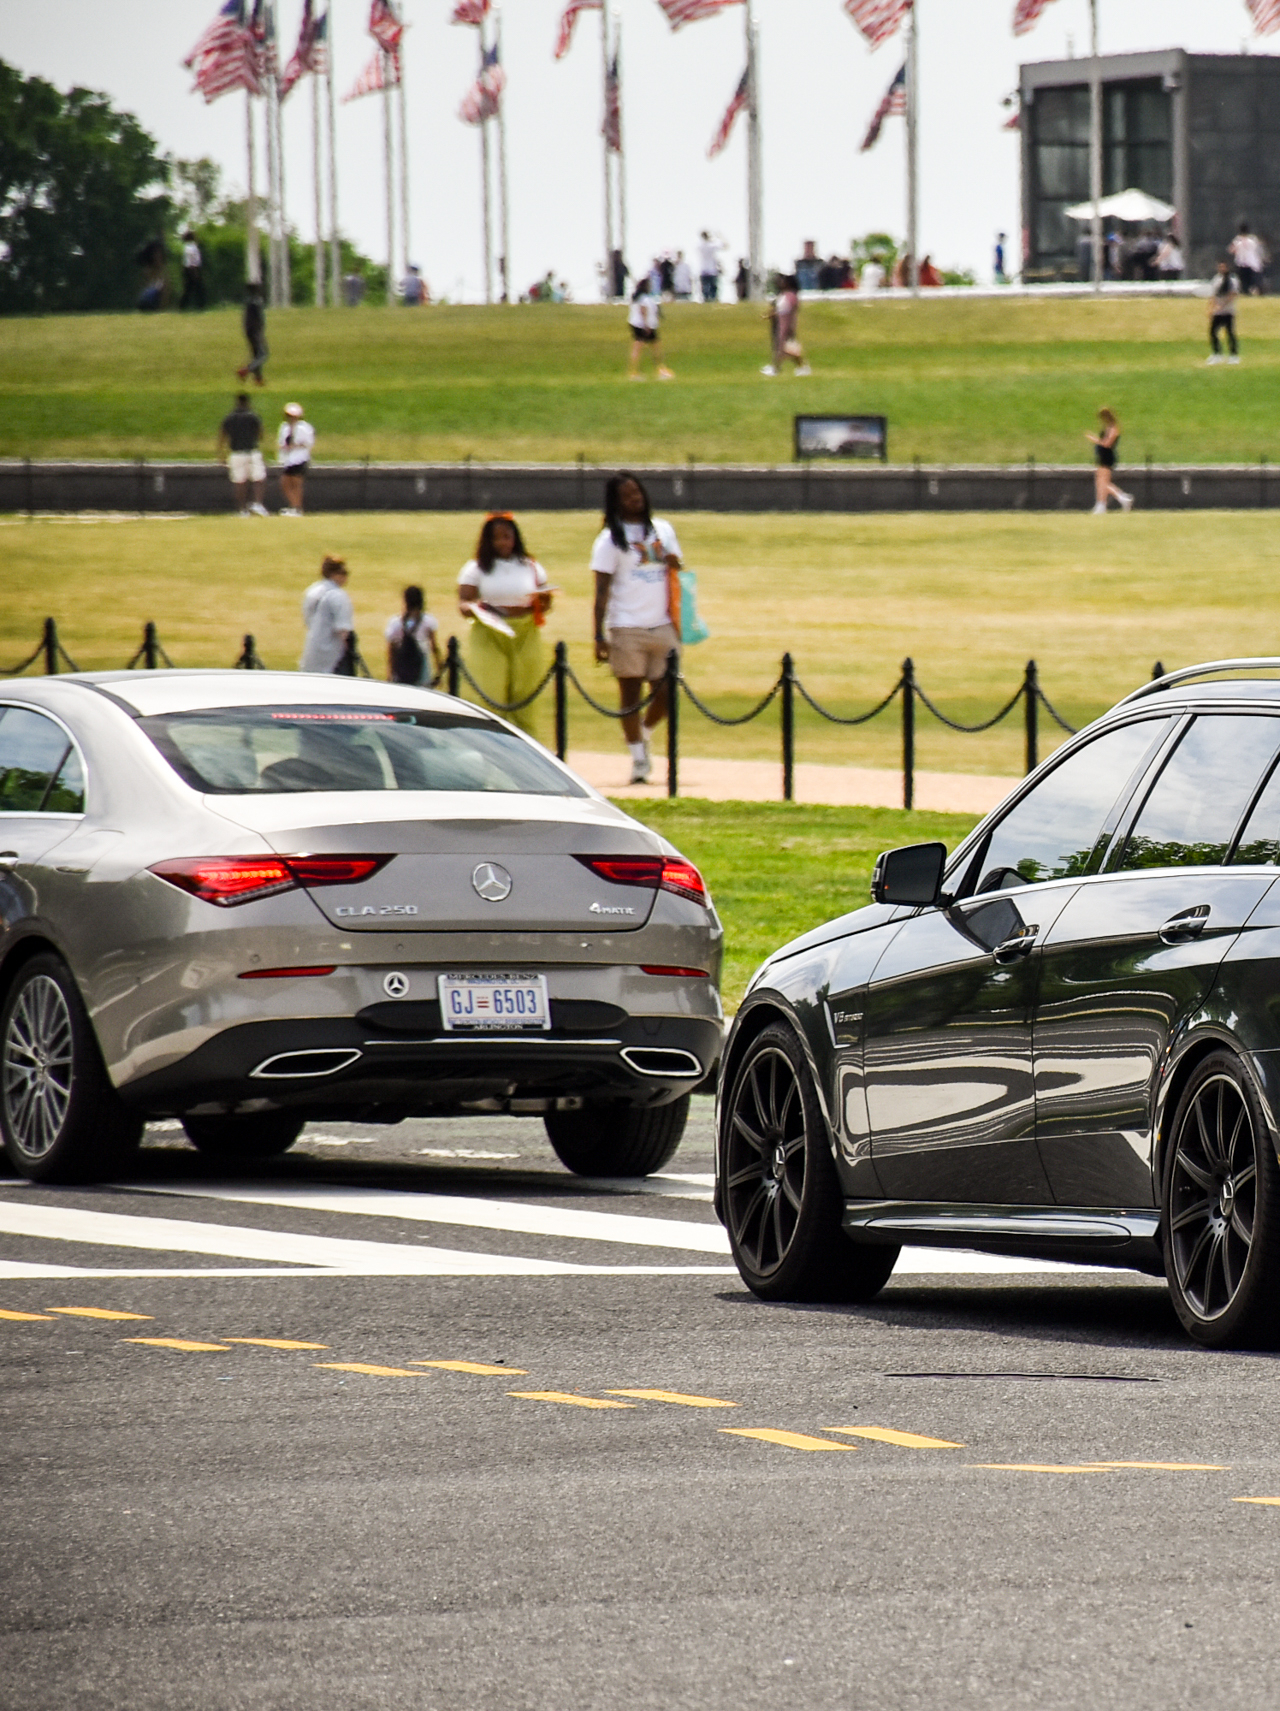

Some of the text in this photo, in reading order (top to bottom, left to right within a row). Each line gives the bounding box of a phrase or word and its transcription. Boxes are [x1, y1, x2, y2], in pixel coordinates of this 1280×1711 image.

[335, 904, 418, 916] CLA 250
[493, 989, 537, 1014] 6503
